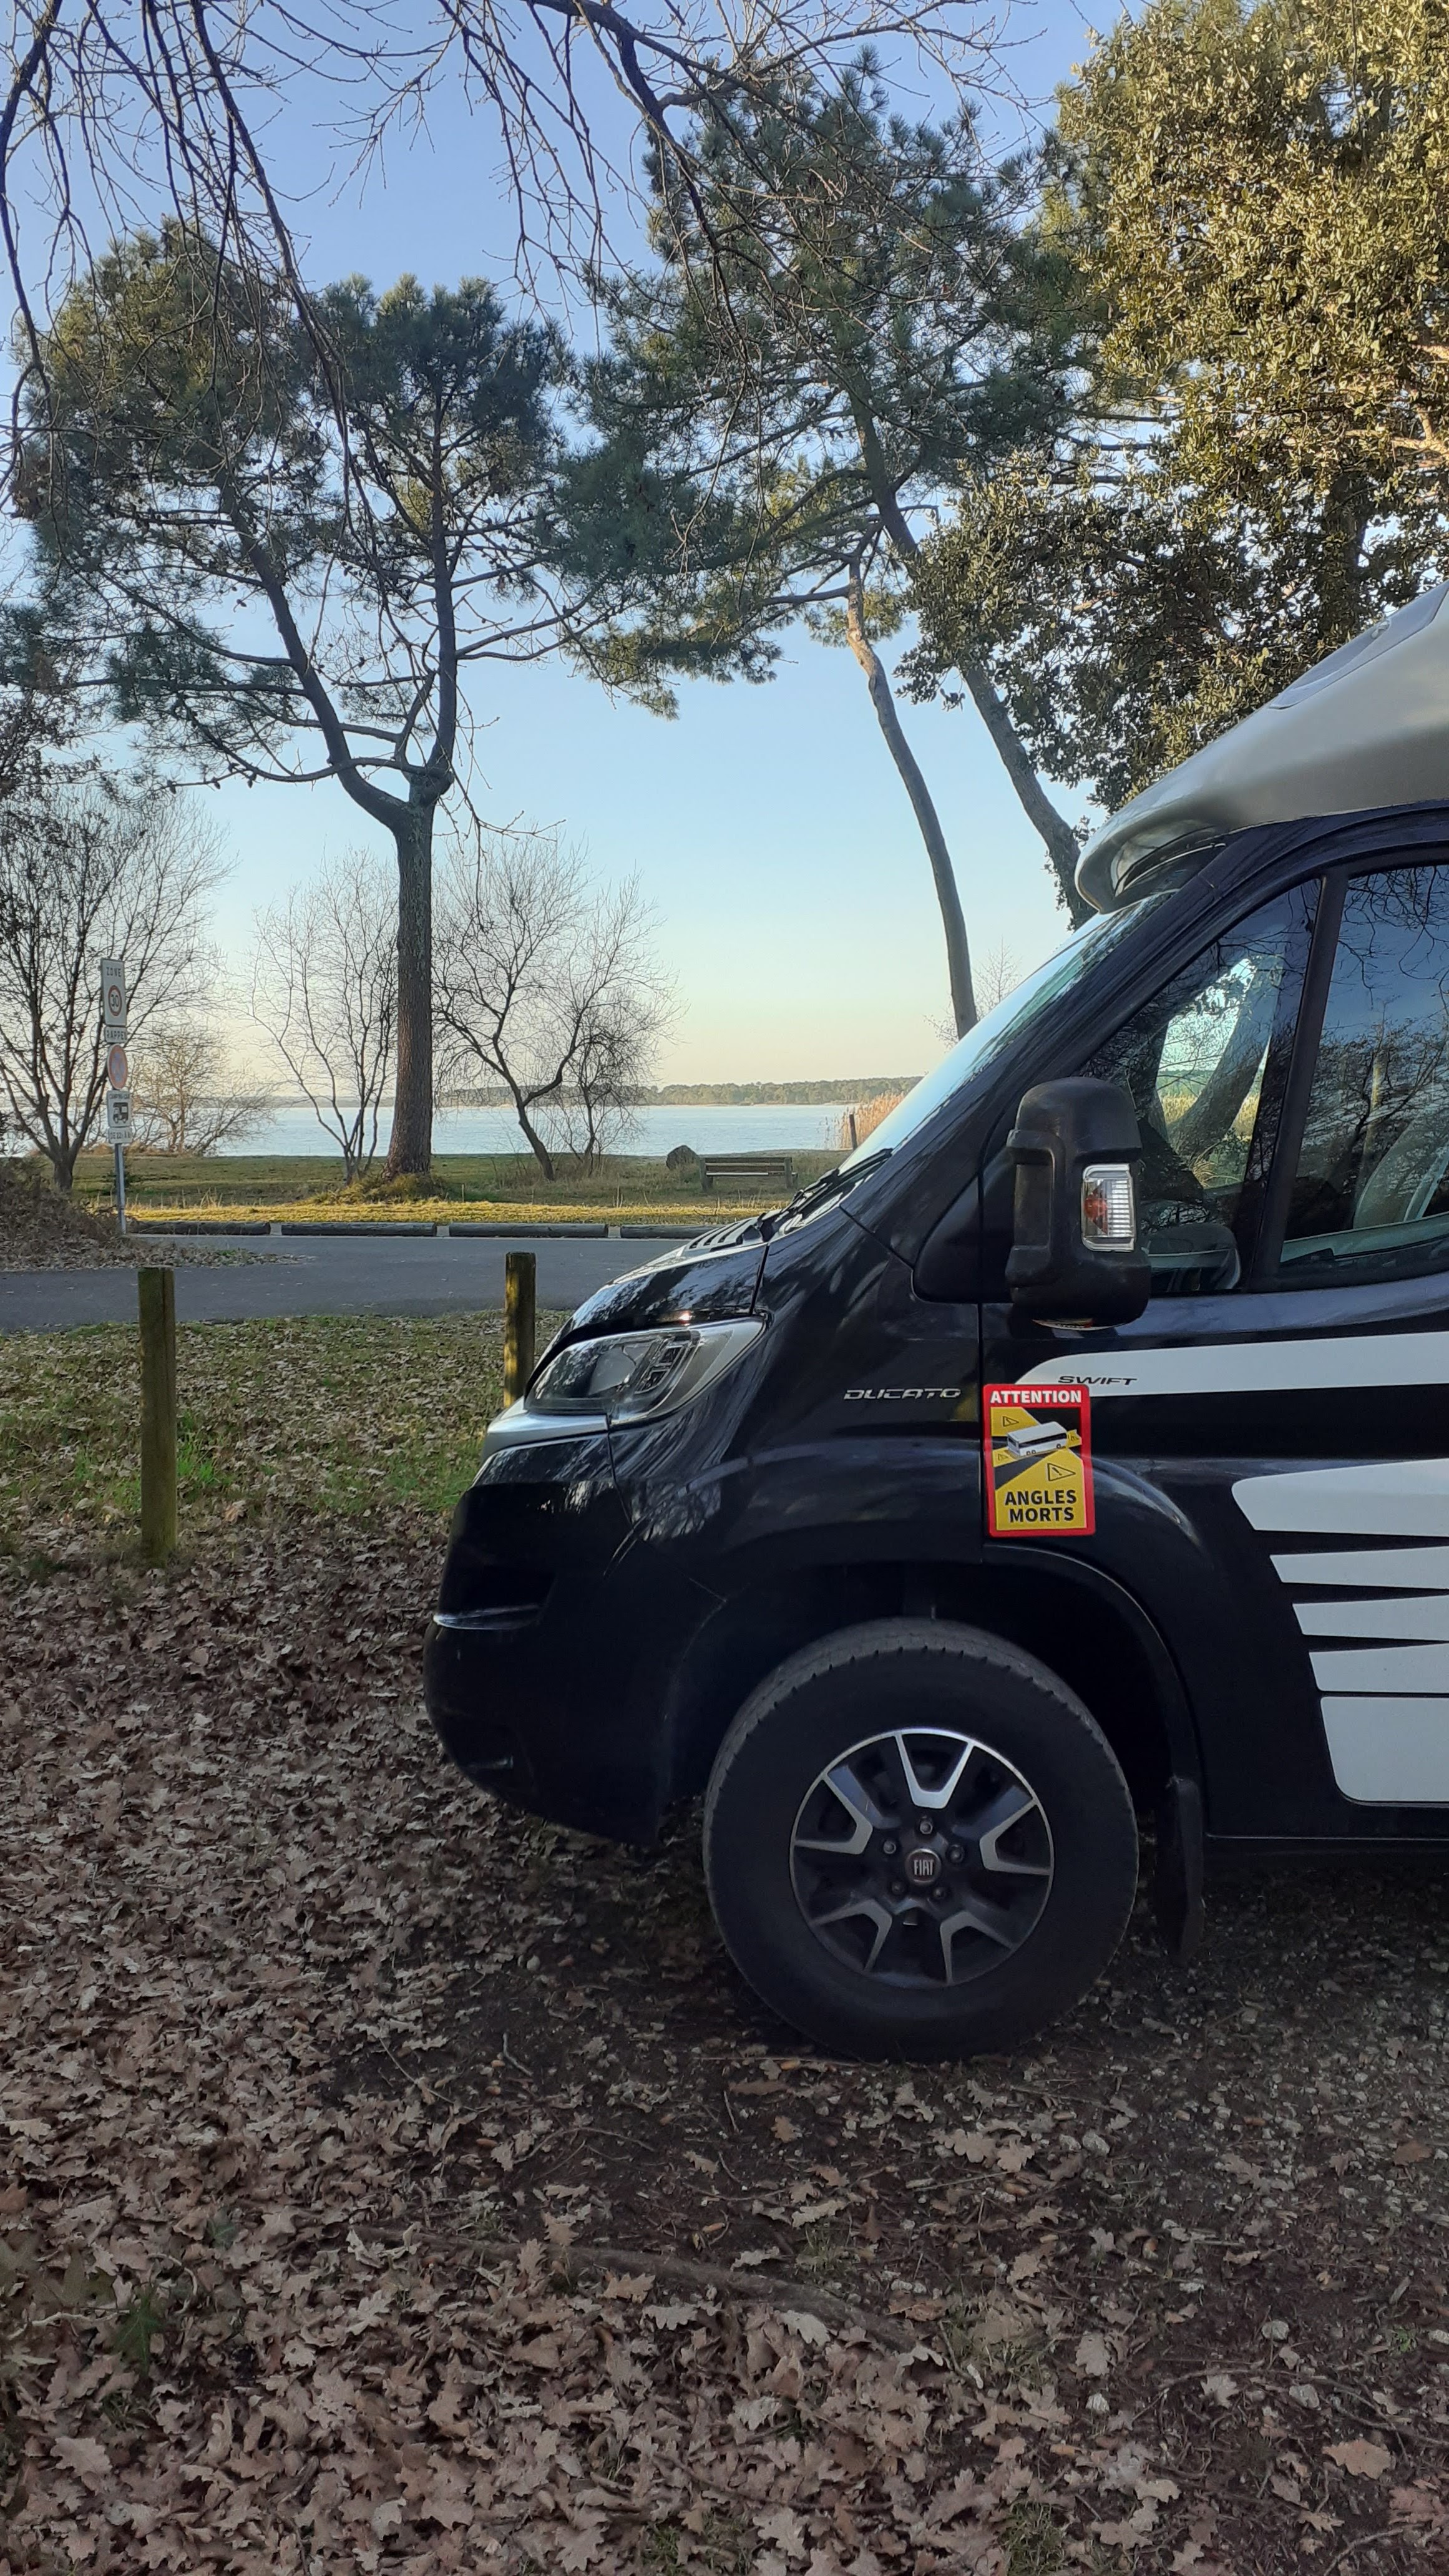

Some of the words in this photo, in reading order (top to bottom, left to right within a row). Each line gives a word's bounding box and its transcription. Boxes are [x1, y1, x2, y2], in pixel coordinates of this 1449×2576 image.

[106, 967, 122, 977] ZONE
[110, 993, 119, 1007] 30
[1058, 1376, 1138, 1385] SWIFT
[844, 1388, 962, 1400] DUCATO
[990, 1390, 1082, 1403] ATTENTION
[1005, 1490, 1077, 1506] ANGLES
[1010, 1507, 1075, 1523] MORTS
[914, 1860, 934, 1876] FIAT
